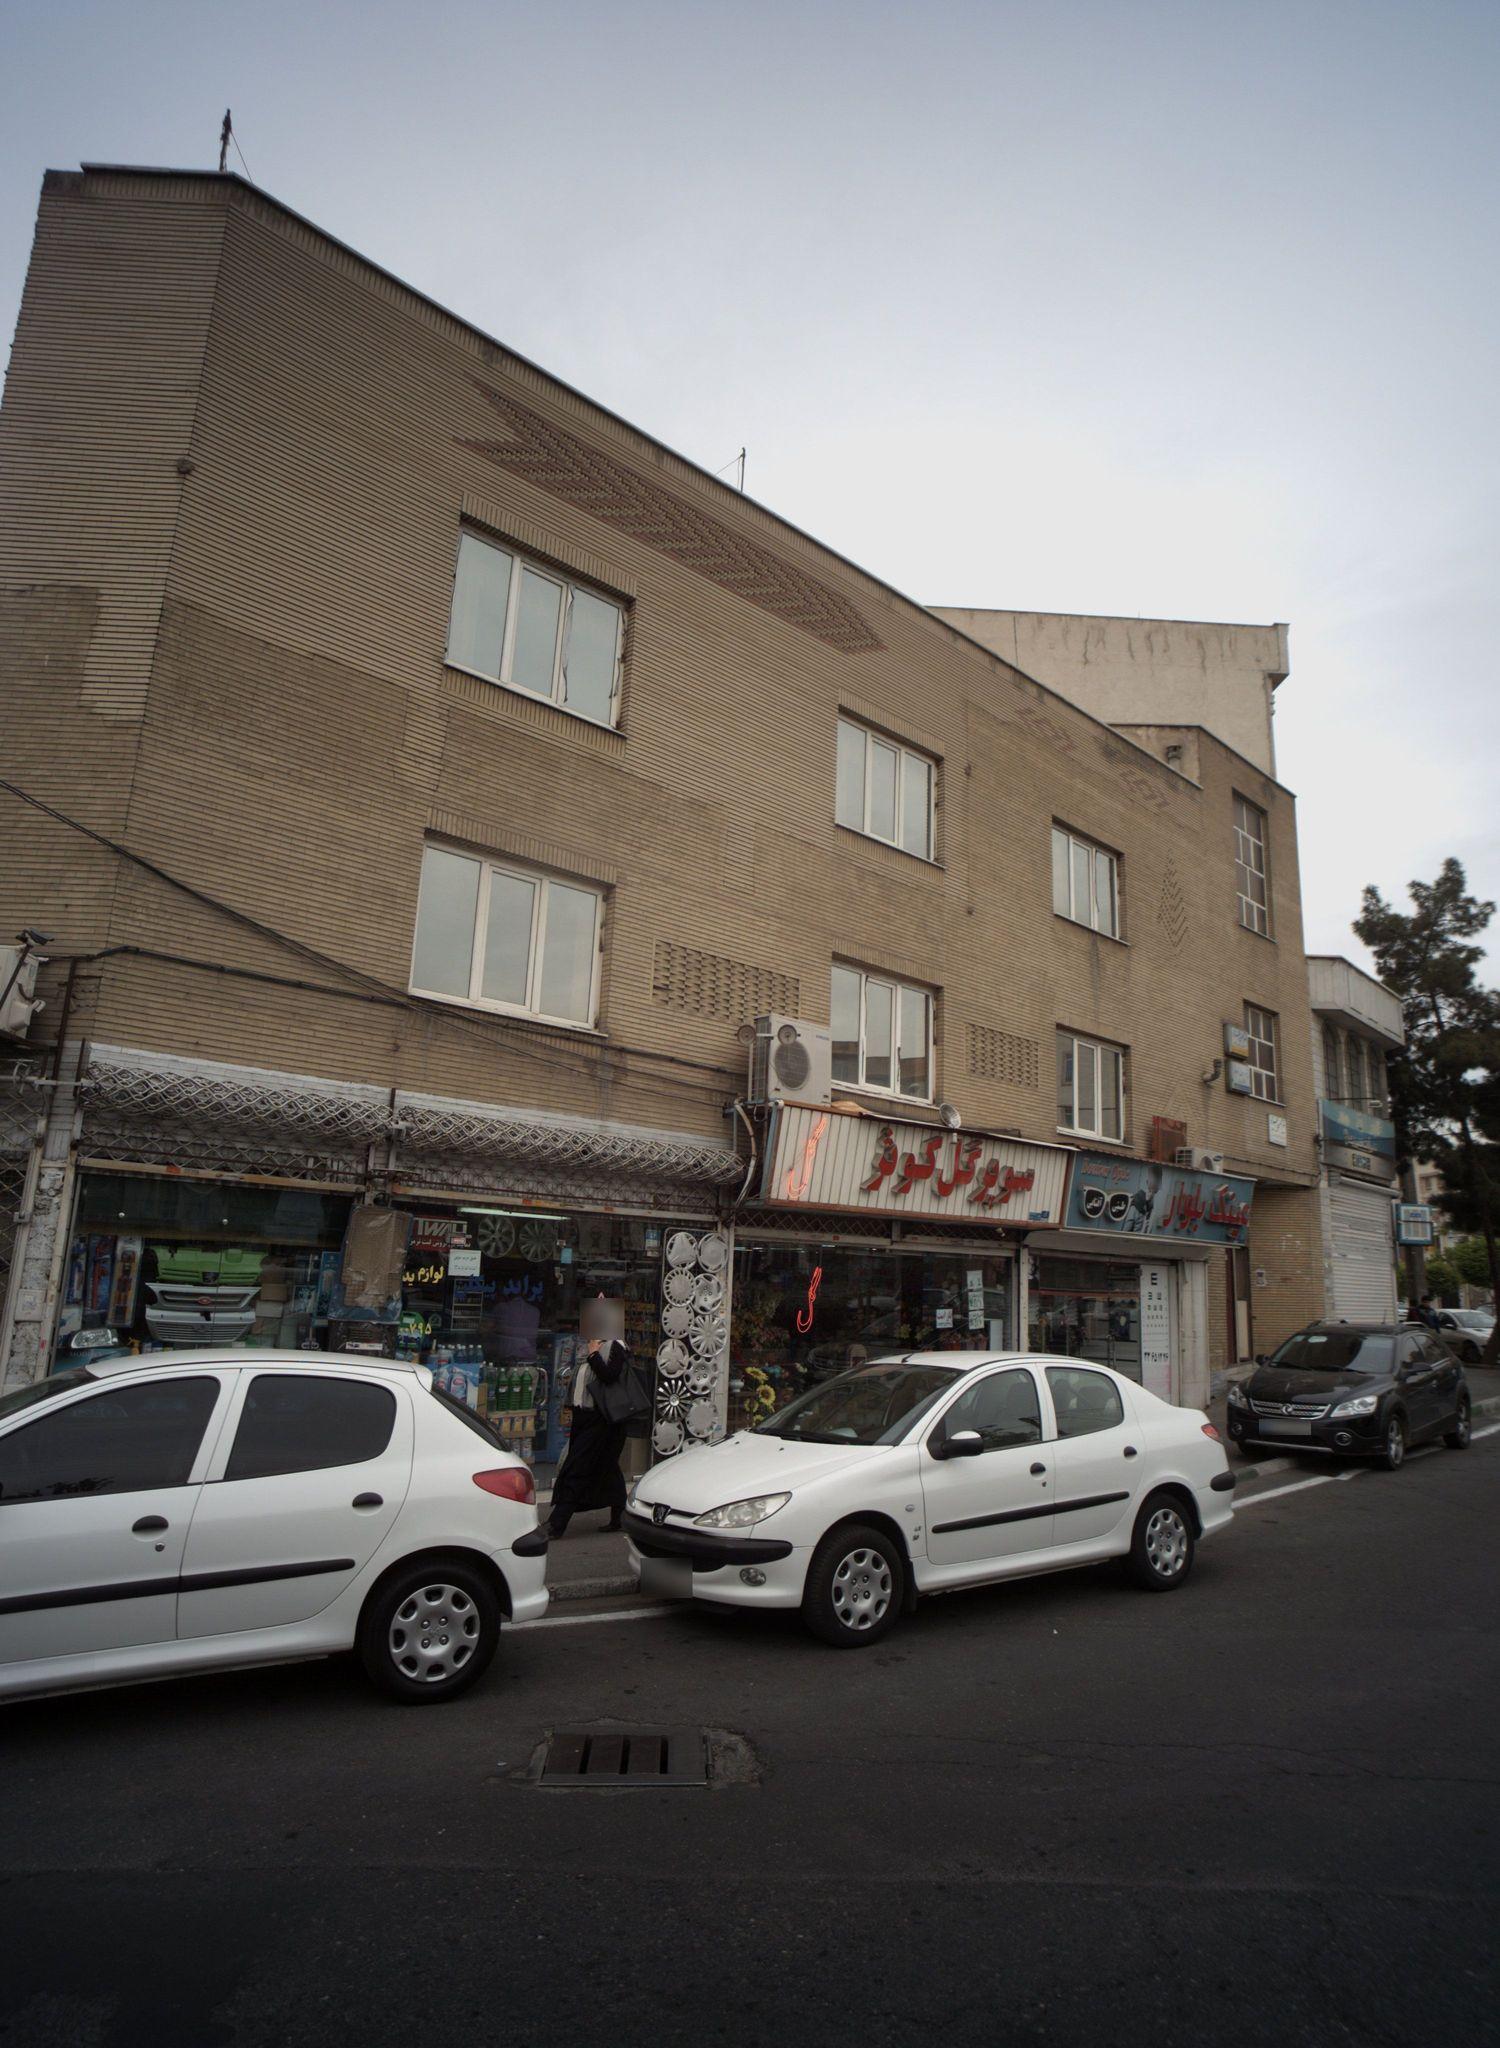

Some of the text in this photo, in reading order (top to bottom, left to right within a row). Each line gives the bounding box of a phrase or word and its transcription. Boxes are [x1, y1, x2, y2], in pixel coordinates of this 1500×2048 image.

[931, 1138, 982, 1197] گل
[967, 1158, 1035, 1210] سوپر
[1159, 1181, 1250, 1240] عینک بلوار
[402, 1271, 415, 1287] ید
[418, 1264, 444, 1284] لوازم
